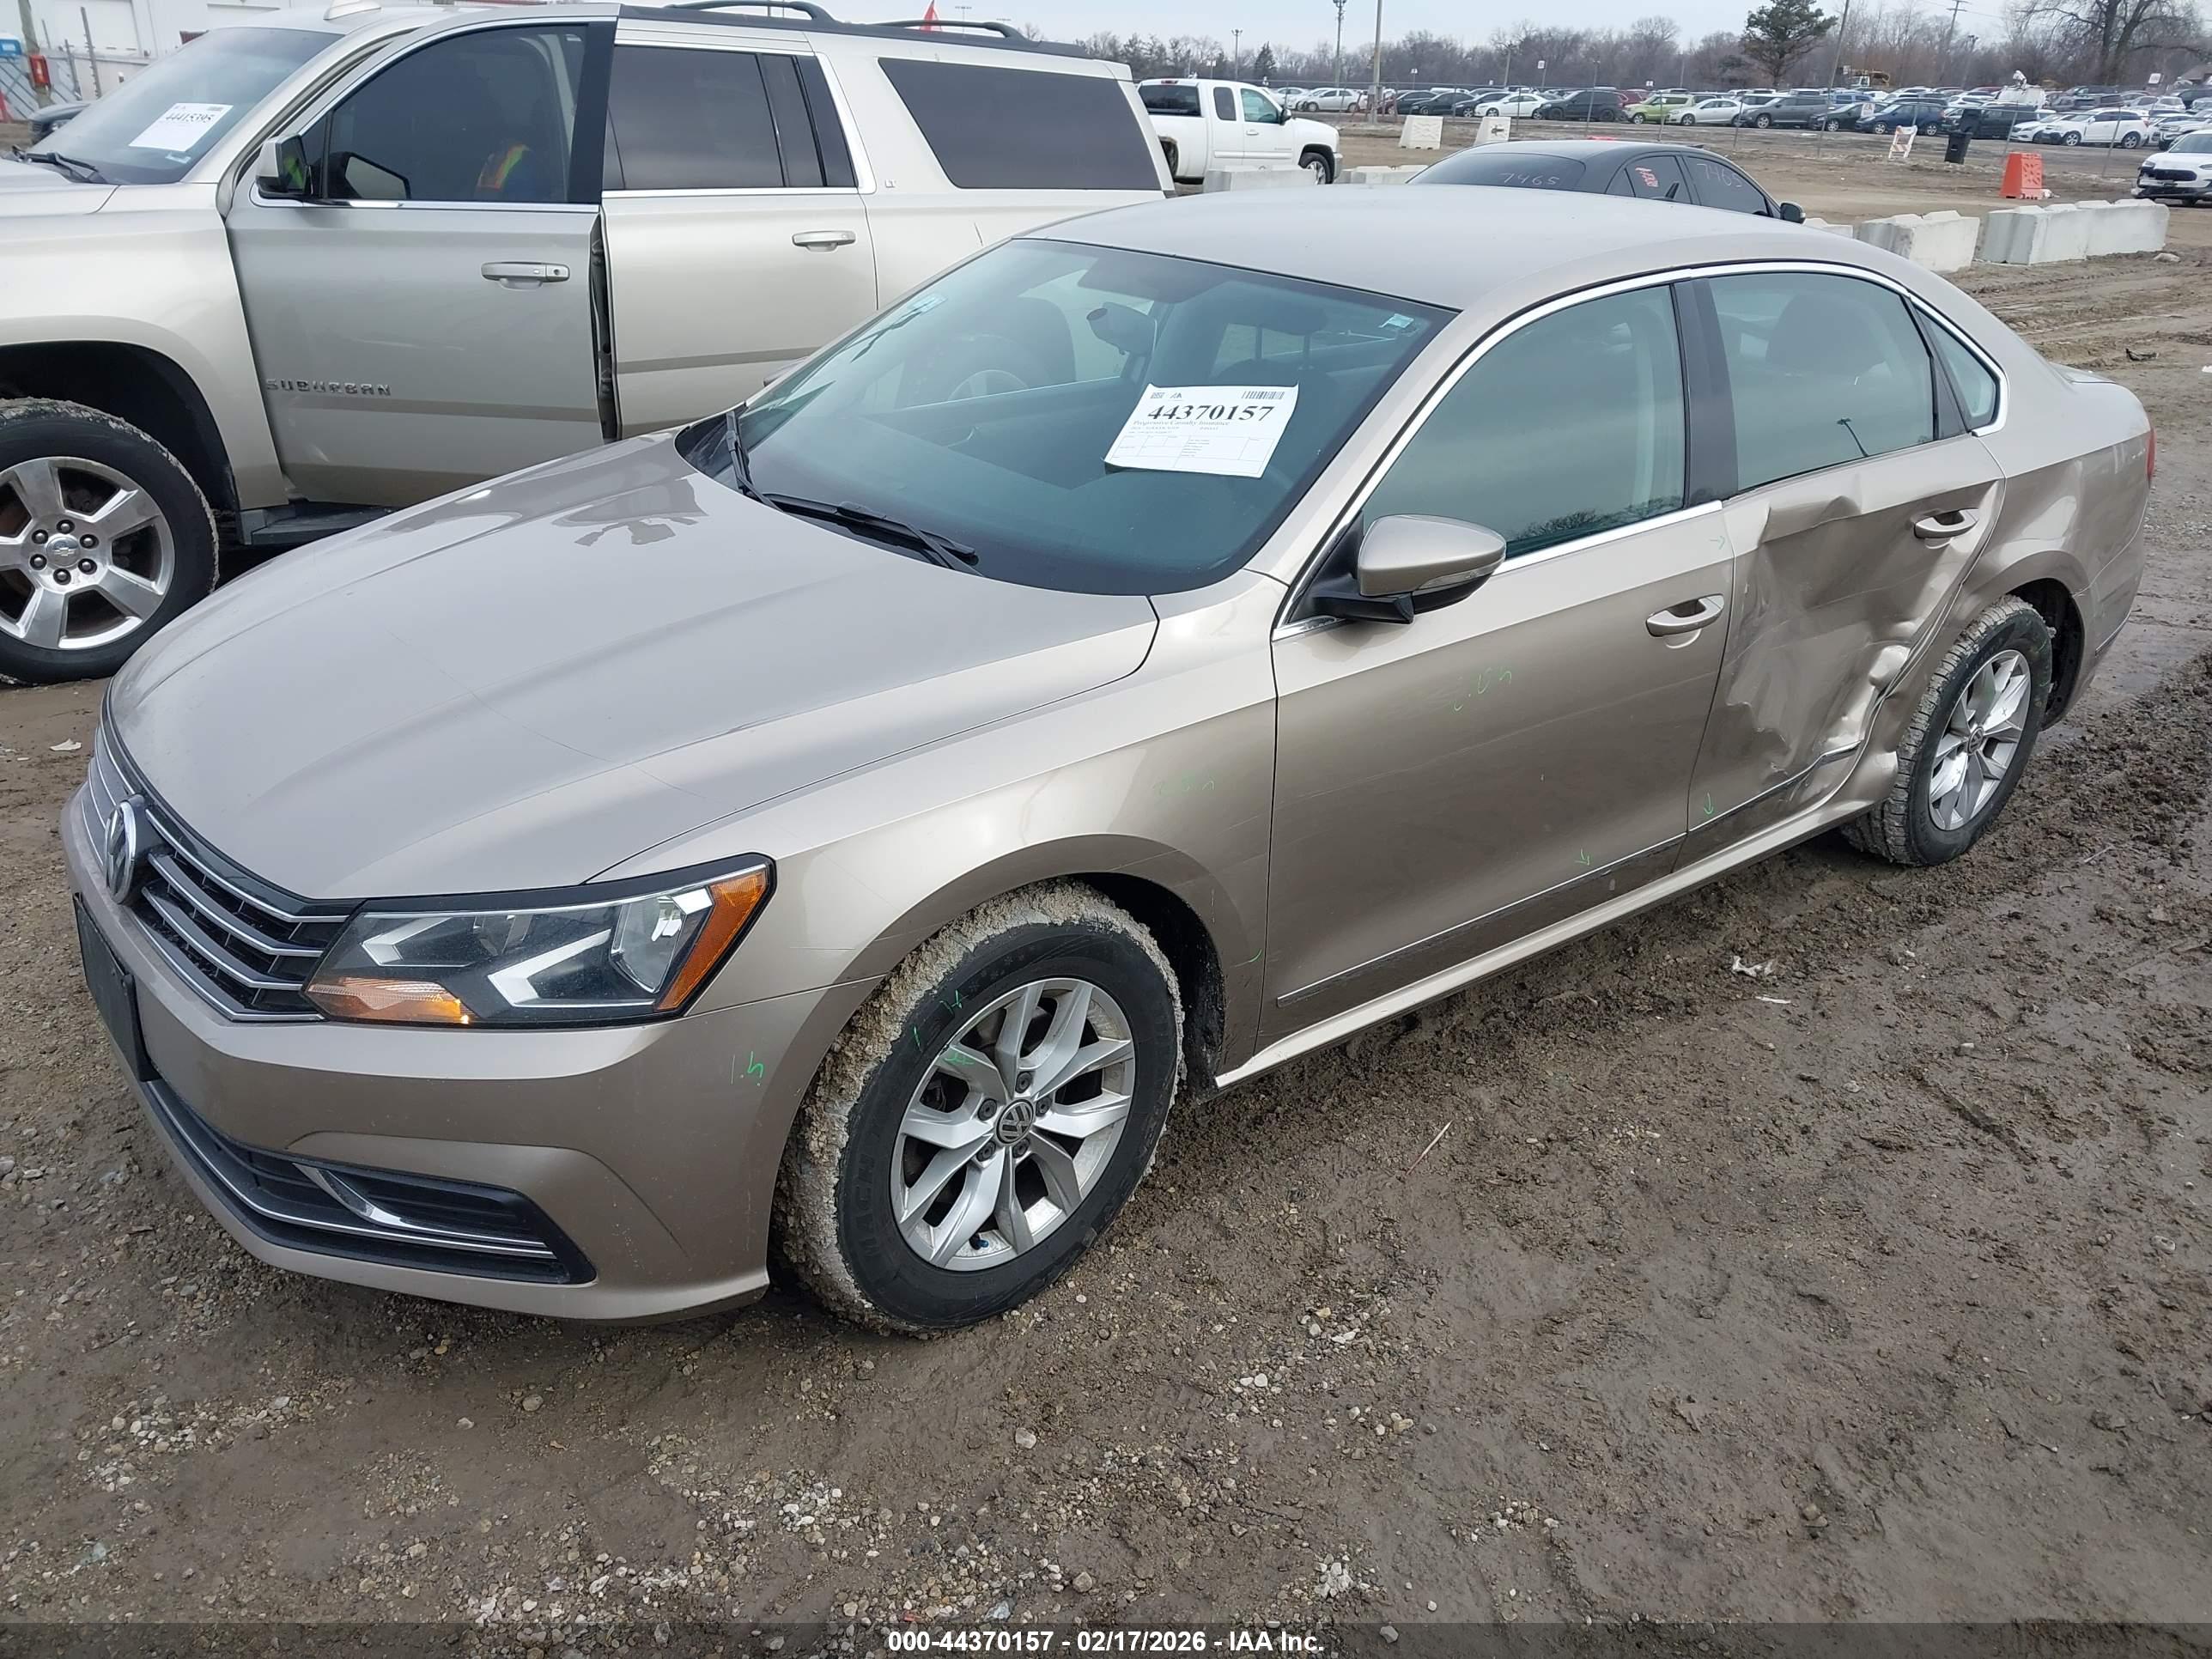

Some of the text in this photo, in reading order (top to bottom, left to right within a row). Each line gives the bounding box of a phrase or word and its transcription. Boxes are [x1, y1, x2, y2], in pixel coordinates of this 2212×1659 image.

[1499, 173, 1560, 185] 7465
[265, 378, 391, 396] SUBURBAN
[1147, 404, 1275, 422] 44370157
